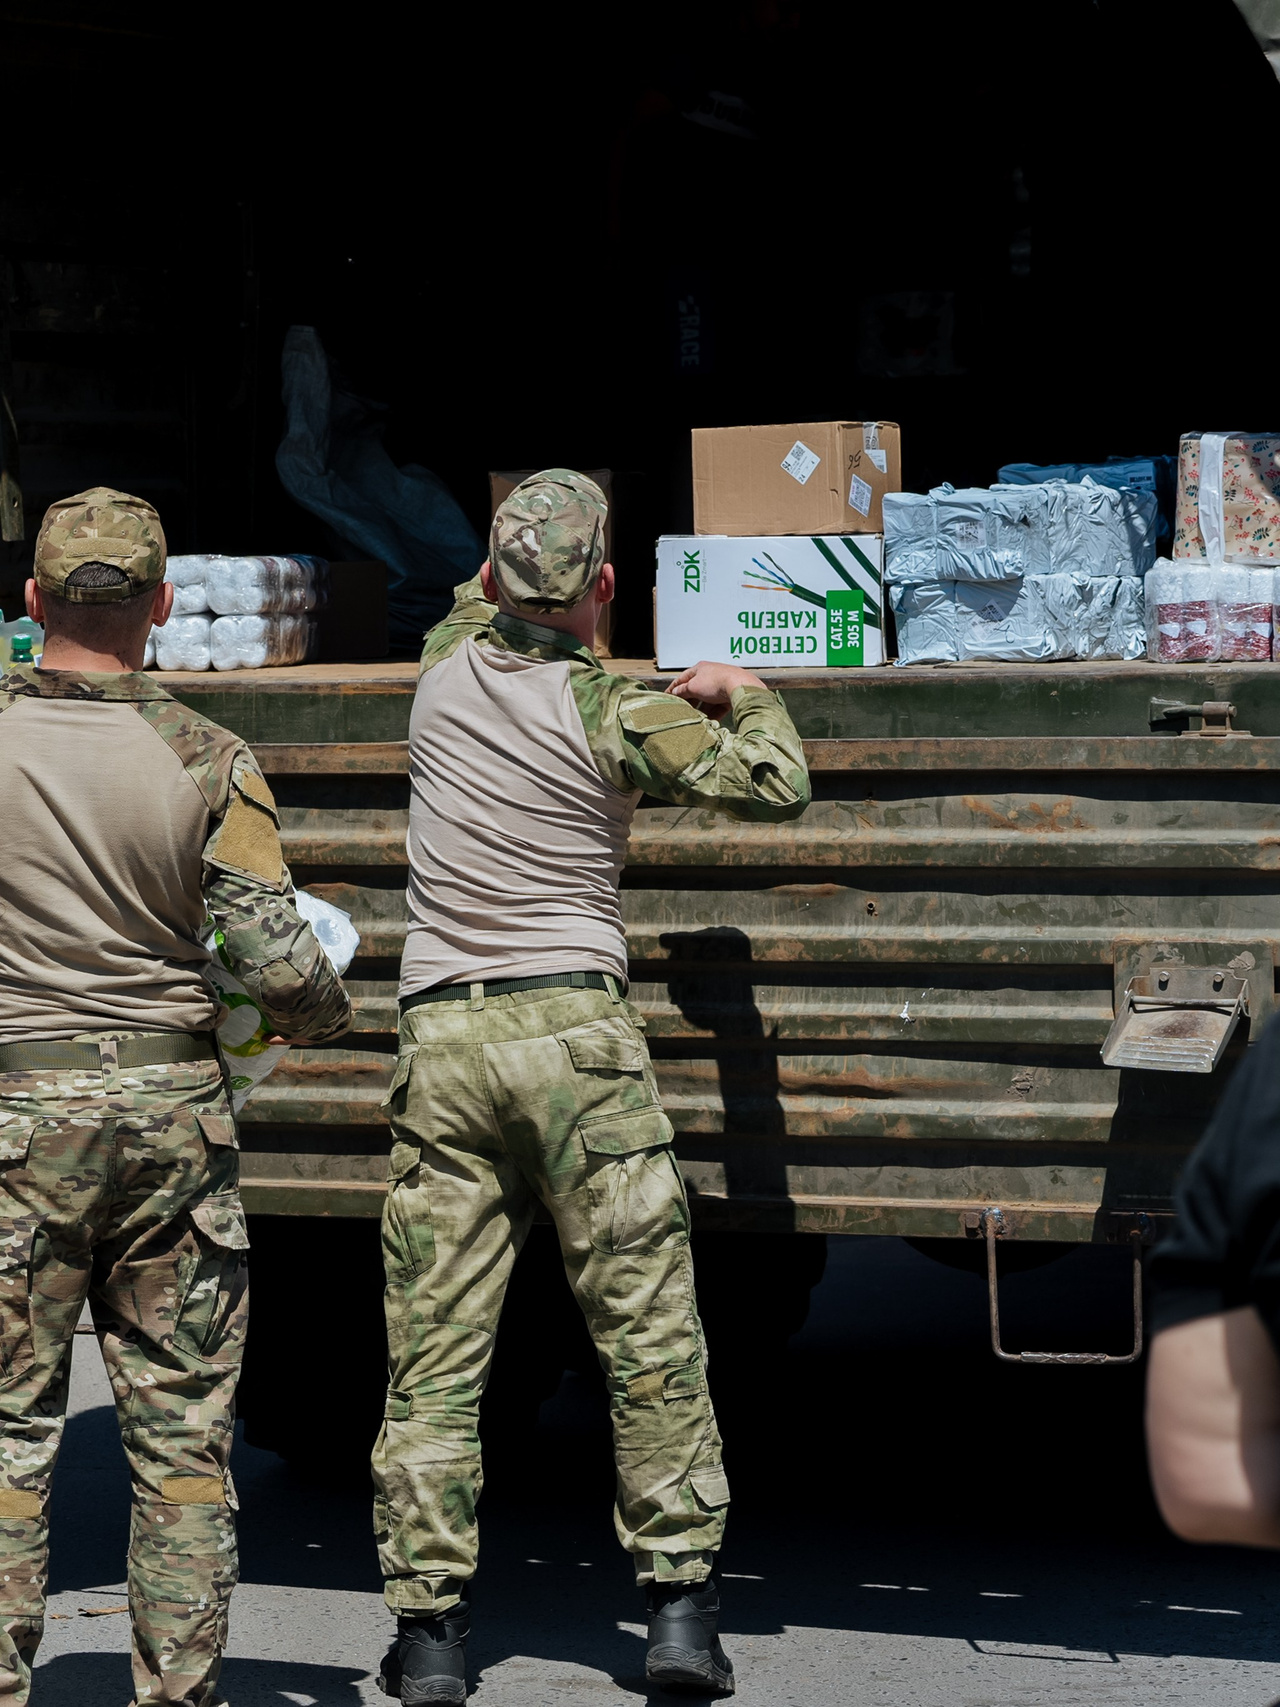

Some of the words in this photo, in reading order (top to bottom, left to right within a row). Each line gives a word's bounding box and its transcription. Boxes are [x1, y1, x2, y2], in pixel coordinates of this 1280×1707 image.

[683, 549, 701, 593] ZDK
[737, 610, 817, 629] КАБЕЛЬ
[830, 608, 843, 650] CAT.5E
[729, 635, 818, 659] СЕТЕВОЙ
[847, 624, 860, 648] 305
